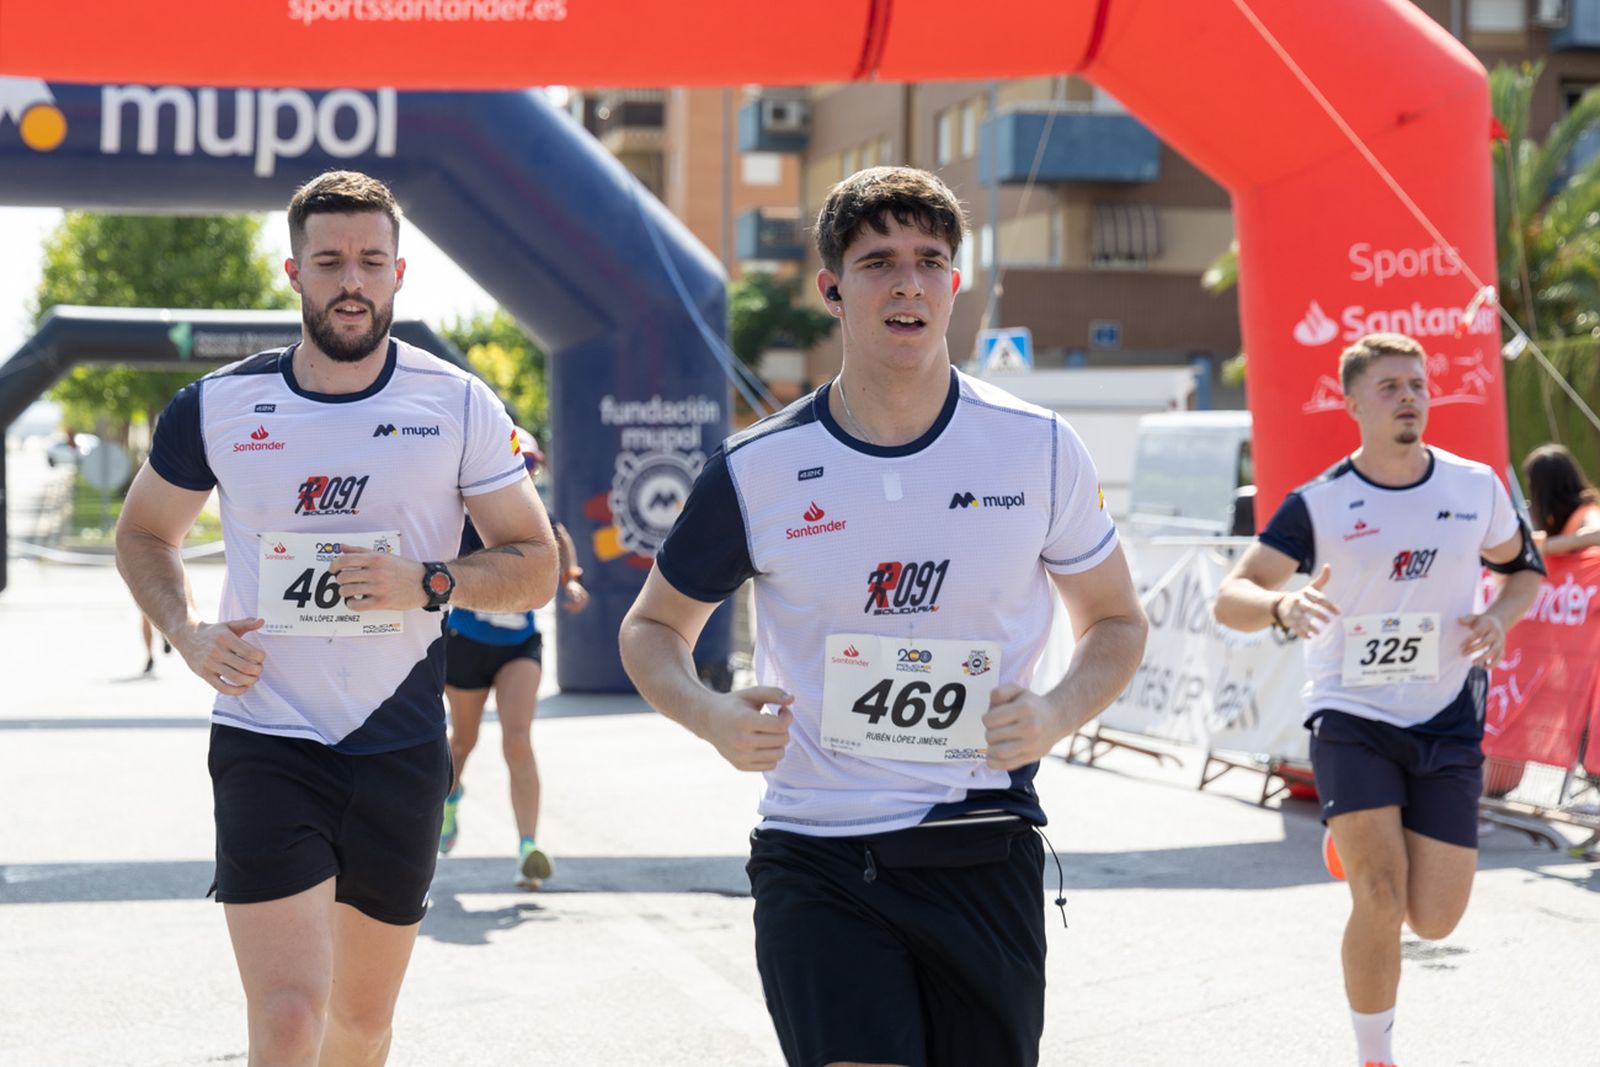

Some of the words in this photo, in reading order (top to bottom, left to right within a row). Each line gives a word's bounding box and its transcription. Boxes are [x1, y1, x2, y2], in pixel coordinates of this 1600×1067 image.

[100, 84, 397, 178] mupol
[1348, 242, 1461, 287] Sports
[402, 425, 440, 437] mupol
[621, 425, 702, 455] mupol
[233, 441, 286, 452] Santander
[983, 491, 1025, 510] mupol
[785, 520, 847, 540] Santander
[283, 568, 350, 609] 46
[1360, 637, 1422, 666] 325
[851, 679, 967, 730] 469
[866, 731, 891, 742] RUBÉN
[891, 734, 916, 745] LÓPEZ
[916, 736, 948, 746] JIMÉNEZ
